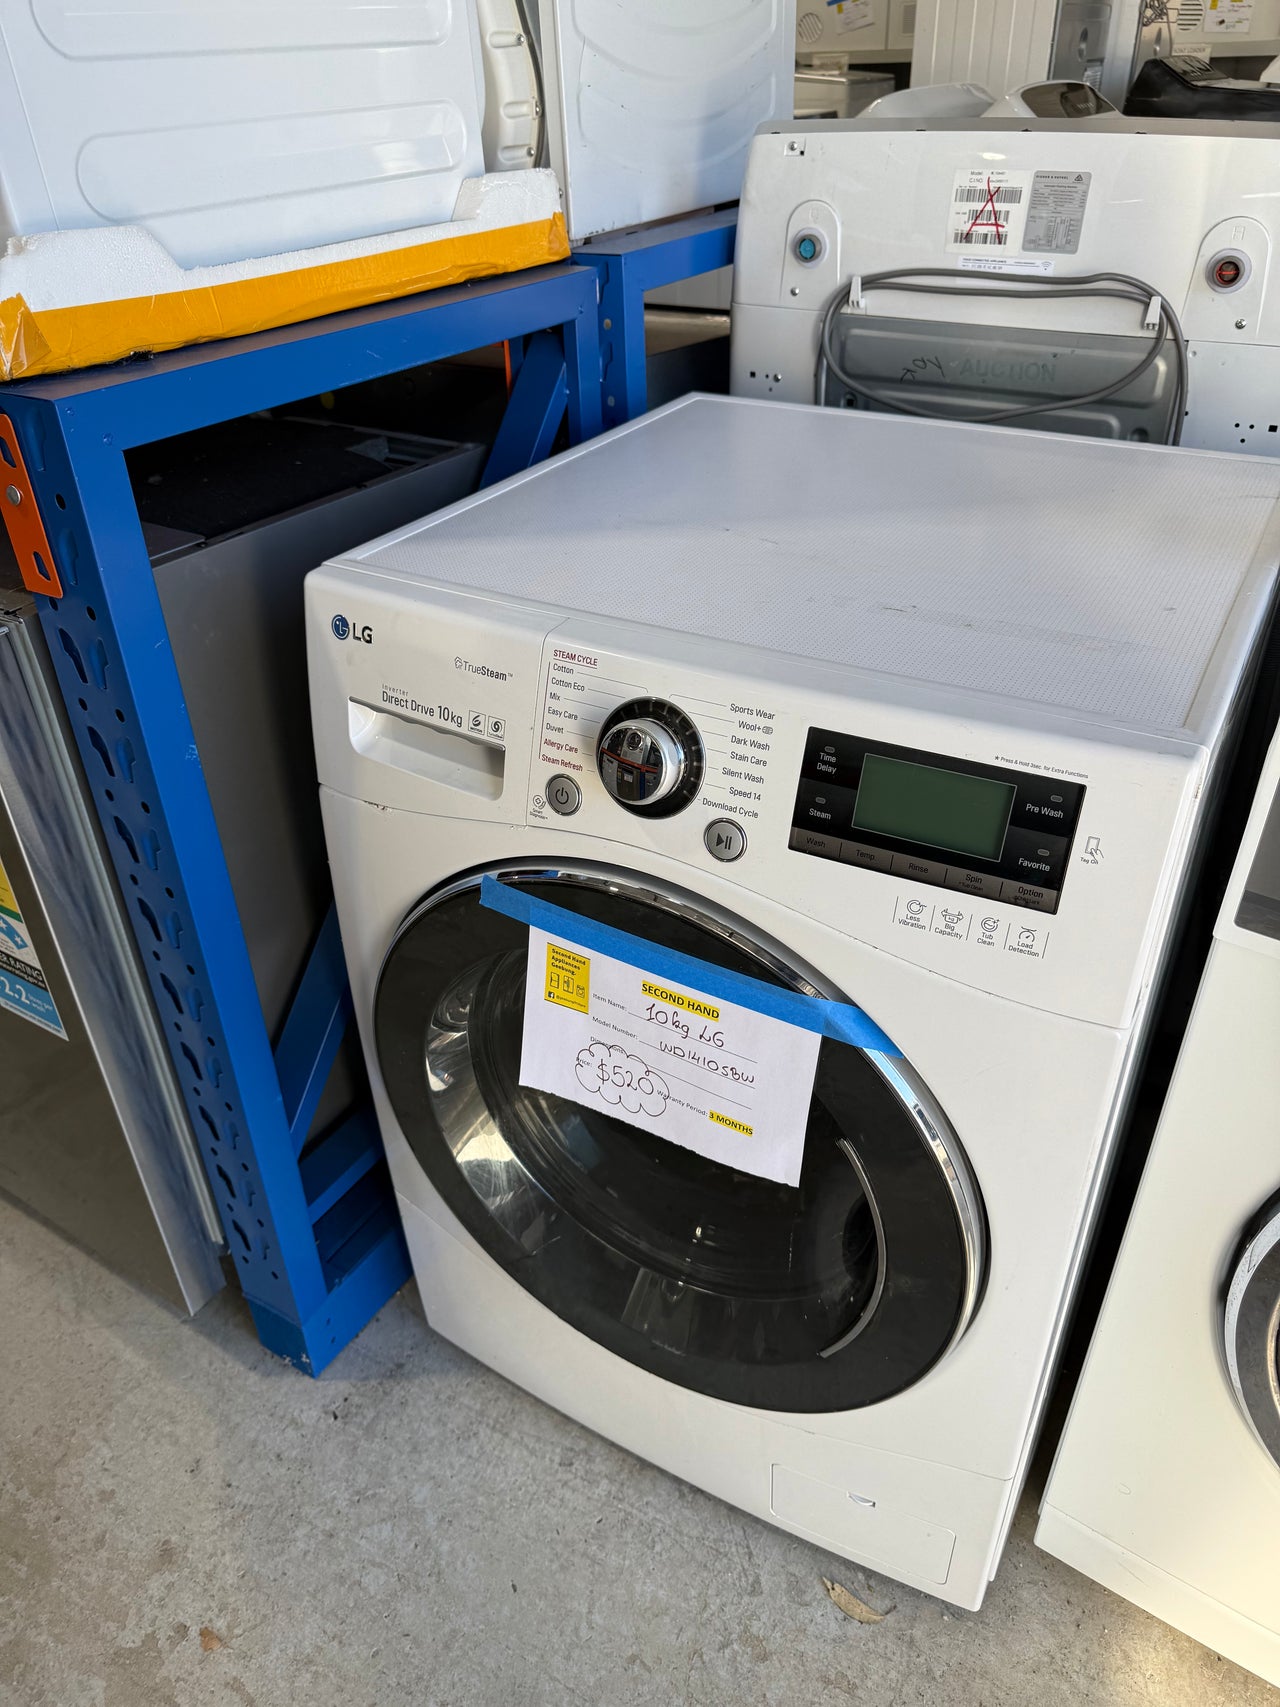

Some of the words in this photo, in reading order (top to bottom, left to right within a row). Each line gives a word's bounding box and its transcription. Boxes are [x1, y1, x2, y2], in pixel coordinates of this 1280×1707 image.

[958, 357, 1057, 384] AUCTION
[352, 622, 374, 644] LG
[553, 649, 577, 661] STEAM
[577, 655, 599, 667] CYCLE
[552, 663, 575, 675] Cotton
[551, 677, 573, 689] Cotton
[572, 682, 585, 692] Eco
[382, 690, 409, 710] Direct
[410, 699, 435, 717] Drive
[549, 692, 561, 701] Mix
[547, 707, 562, 718] Easy
[563, 710, 579, 721] Care
[730, 703, 754, 716] Sports
[755, 708, 775, 720] Wear
[545, 722, 565, 734] Duvet
[738, 720, 762, 733] Wool+
[543, 738, 564, 751] Allergy
[564, 743, 579, 754] Care
[731, 735, 748, 746] Dark
[749, 741, 770, 751] Wash
[541, 753, 561, 766] Steam
[560, 759, 583, 772] Refresh
[730, 751, 749, 763] Stain
[750, 756, 768, 767] Care
[819, 752, 837, 763] Time
[816, 762, 837, 775] Delay
[1001, 756, 1014, 764] Press
[1065, 770, 1089, 779] Functions
[721, 767, 743, 779] Silent
[743, 773, 765, 784] Wash
[729, 787, 752, 799] Speed
[753, 793, 762, 801] 14
[702, 798, 738, 813] Download
[738, 807, 759, 819] Cycle
[808, 807, 832, 820] Steam
[1025, 803, 1040, 813] Pre
[1041, 807, 1064, 819] Wash
[806, 836, 826, 848] Wash
[1018, 858, 1051, 873] Favorite
[1080, 857, 1090, 865] Tag
[908, 863, 929, 874] Rinse
[966, 874, 983, 885] Spin
[1018, 886, 1044, 899] Option
[898, 918, 926, 931] Vibration
[905, 913, 921, 923] Less
[934, 927, 963, 940] Capacity
[944, 923, 955, 932] Big
[977, 938, 995, 947] Clean
[982, 932, 994, 941] Tub
[1008, 945, 1040, 958] Detection
[1017, 940, 1033, 950] Load
[551, 948, 571, 960] Second
[571, 955, 586, 966] Hand
[551, 955, 581, 971] Appliances
[9, 956, 43, 981] RATING
[592, 993, 607, 1003] Item
[607, 998, 627, 1012] Name:
[641, 983, 684, 1006] SECOND
[687, 1000, 720, 1019] HAND
[592, 1016, 611, 1029] Model
[611, 1024, 638, 1040] Number:
[596, 1058, 654, 1096] $520
[685, 1102, 708, 1117] Period:
[709, 1111, 715, 1119] 3
[716, 1115, 754, 1135] MONTHS
